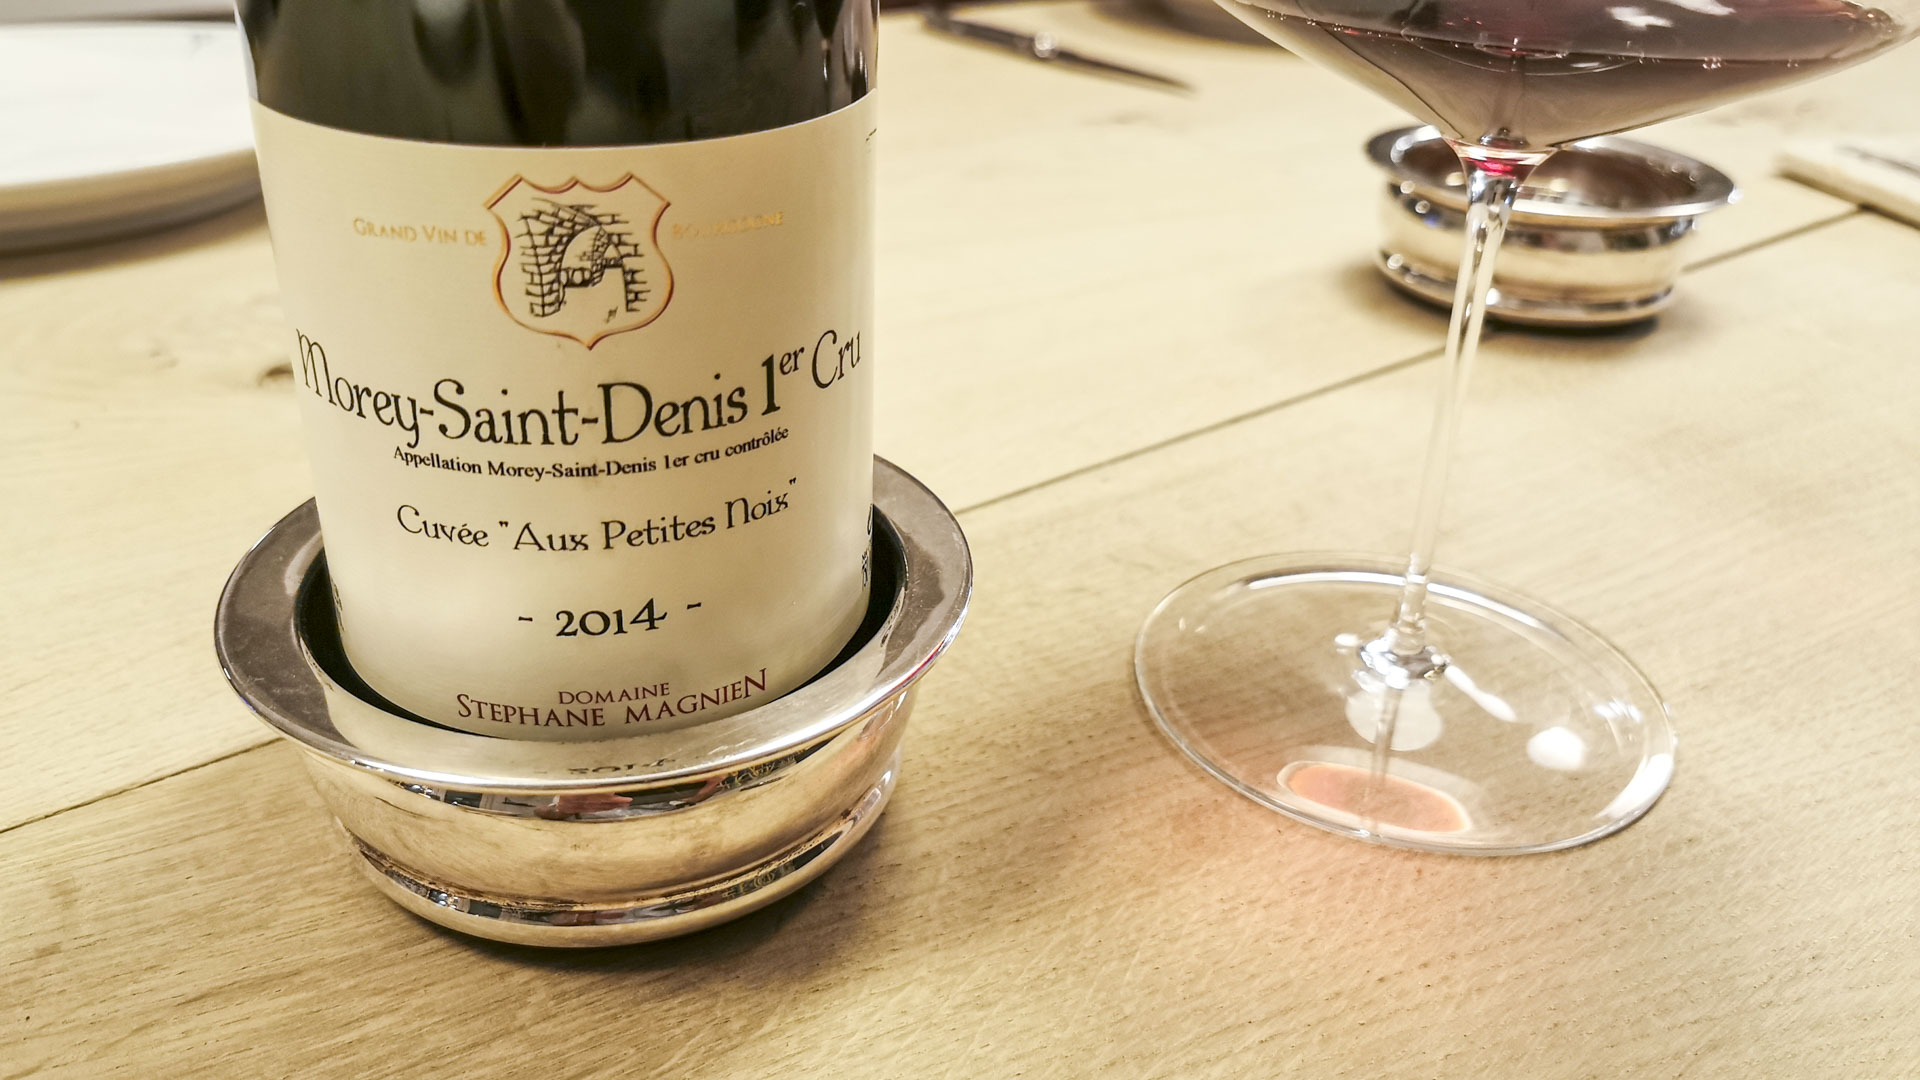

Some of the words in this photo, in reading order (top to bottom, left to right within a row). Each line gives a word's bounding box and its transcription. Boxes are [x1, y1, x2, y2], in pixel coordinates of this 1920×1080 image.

[353, 218, 417, 243] GRAND
[422, 224, 458, 243] VIN
[465, 229, 487, 246] DE
[296, 327, 749, 448] Morey-Saint-Denis
[760, 346, 806, 416] 1er
[811, 329, 861, 389] Cru
[394, 446, 482, 474] Appellation
[487, 457, 657, 482] Morey-Saint-Denis
[664, 454, 690, 470] 1er
[694, 449, 720, 464] cru
[725, 426, 789, 457] contrôlée
[397, 504, 490, 547] Cuvée
[600, 515, 716, 550] Petites
[555, 597, 668, 637] 2014
[456, 693, 606, 727] STEPHANE
[624, 668, 767, 724] MAGNIEN
[558, 682, 670, 705] DOMAINE
